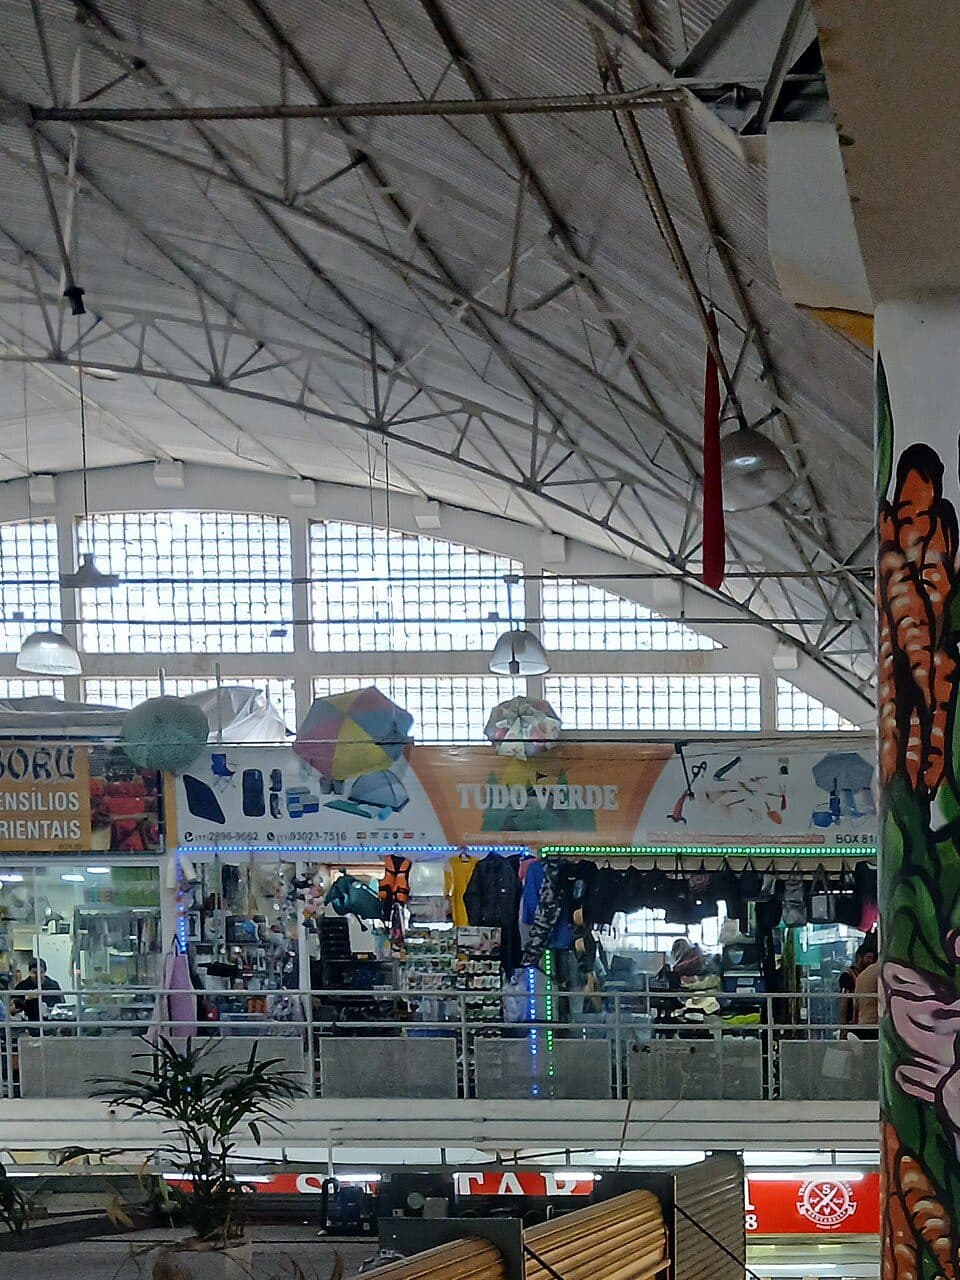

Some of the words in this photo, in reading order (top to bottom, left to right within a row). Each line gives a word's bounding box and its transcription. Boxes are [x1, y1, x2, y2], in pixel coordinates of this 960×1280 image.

[456, 783, 528, 810] TUDO
[532, 784, 620, 811] VERDE
[836, 834, 859, 844] BOX
